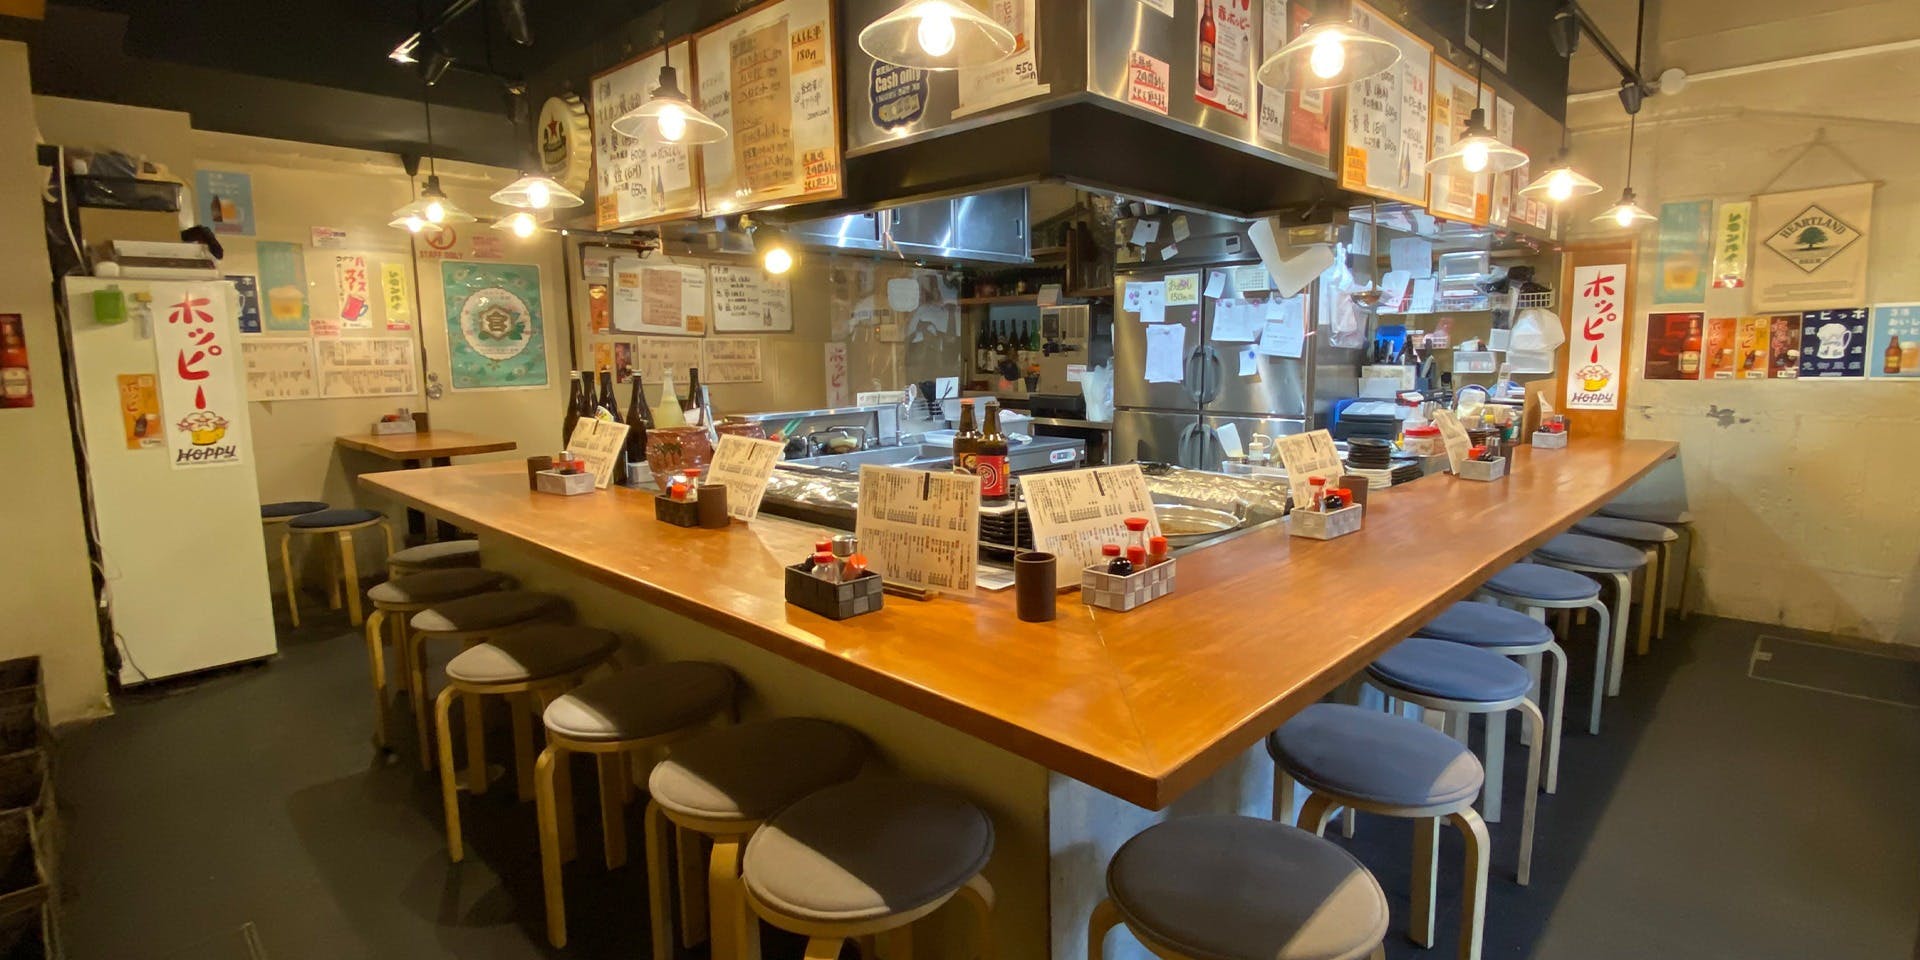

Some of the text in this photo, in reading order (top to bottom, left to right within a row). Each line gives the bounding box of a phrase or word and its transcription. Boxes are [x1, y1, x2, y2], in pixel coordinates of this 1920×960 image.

[875, 69, 898, 93] Cash
[1779, 217, 1847, 239] HEARTLAND
[419, 250, 444, 258] STAFF
[1583, 270, 1617, 364] ホッピー
[168, 289, 222, 410] ホッピー
[1571, 392, 1615, 404] HOPPY
[176, 445, 237, 463] HOPPY
